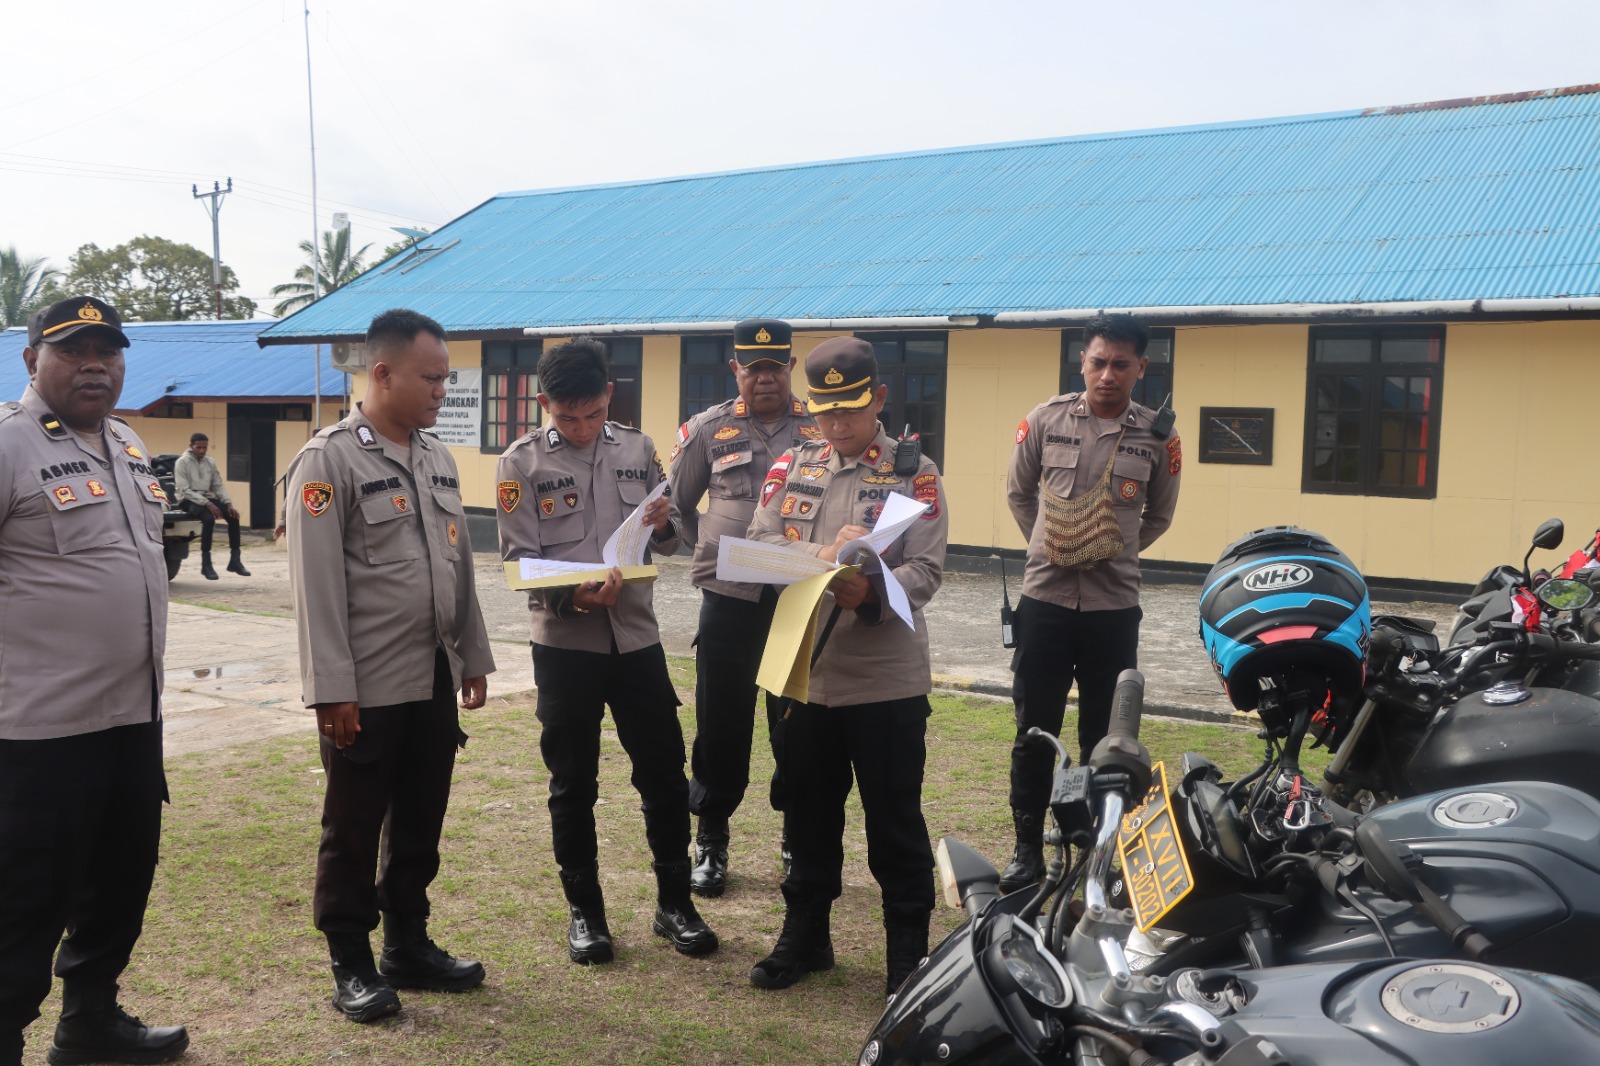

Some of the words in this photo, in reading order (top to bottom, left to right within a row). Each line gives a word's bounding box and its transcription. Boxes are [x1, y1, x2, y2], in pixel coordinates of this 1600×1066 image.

[440, 397, 478, 408] YANGKARI
[1046, 434, 1072, 445] JOSHUA
[1118, 445, 1151, 459] POLRI
[40, 460, 91, 482] ABNER
[128, 461, 154, 477] POL
[537, 476, 576, 494] MILAN
[858, 488, 902, 501] POL
[1252, 567, 1303, 588] NHK
[1150, 821, 1184, 894] XVII
